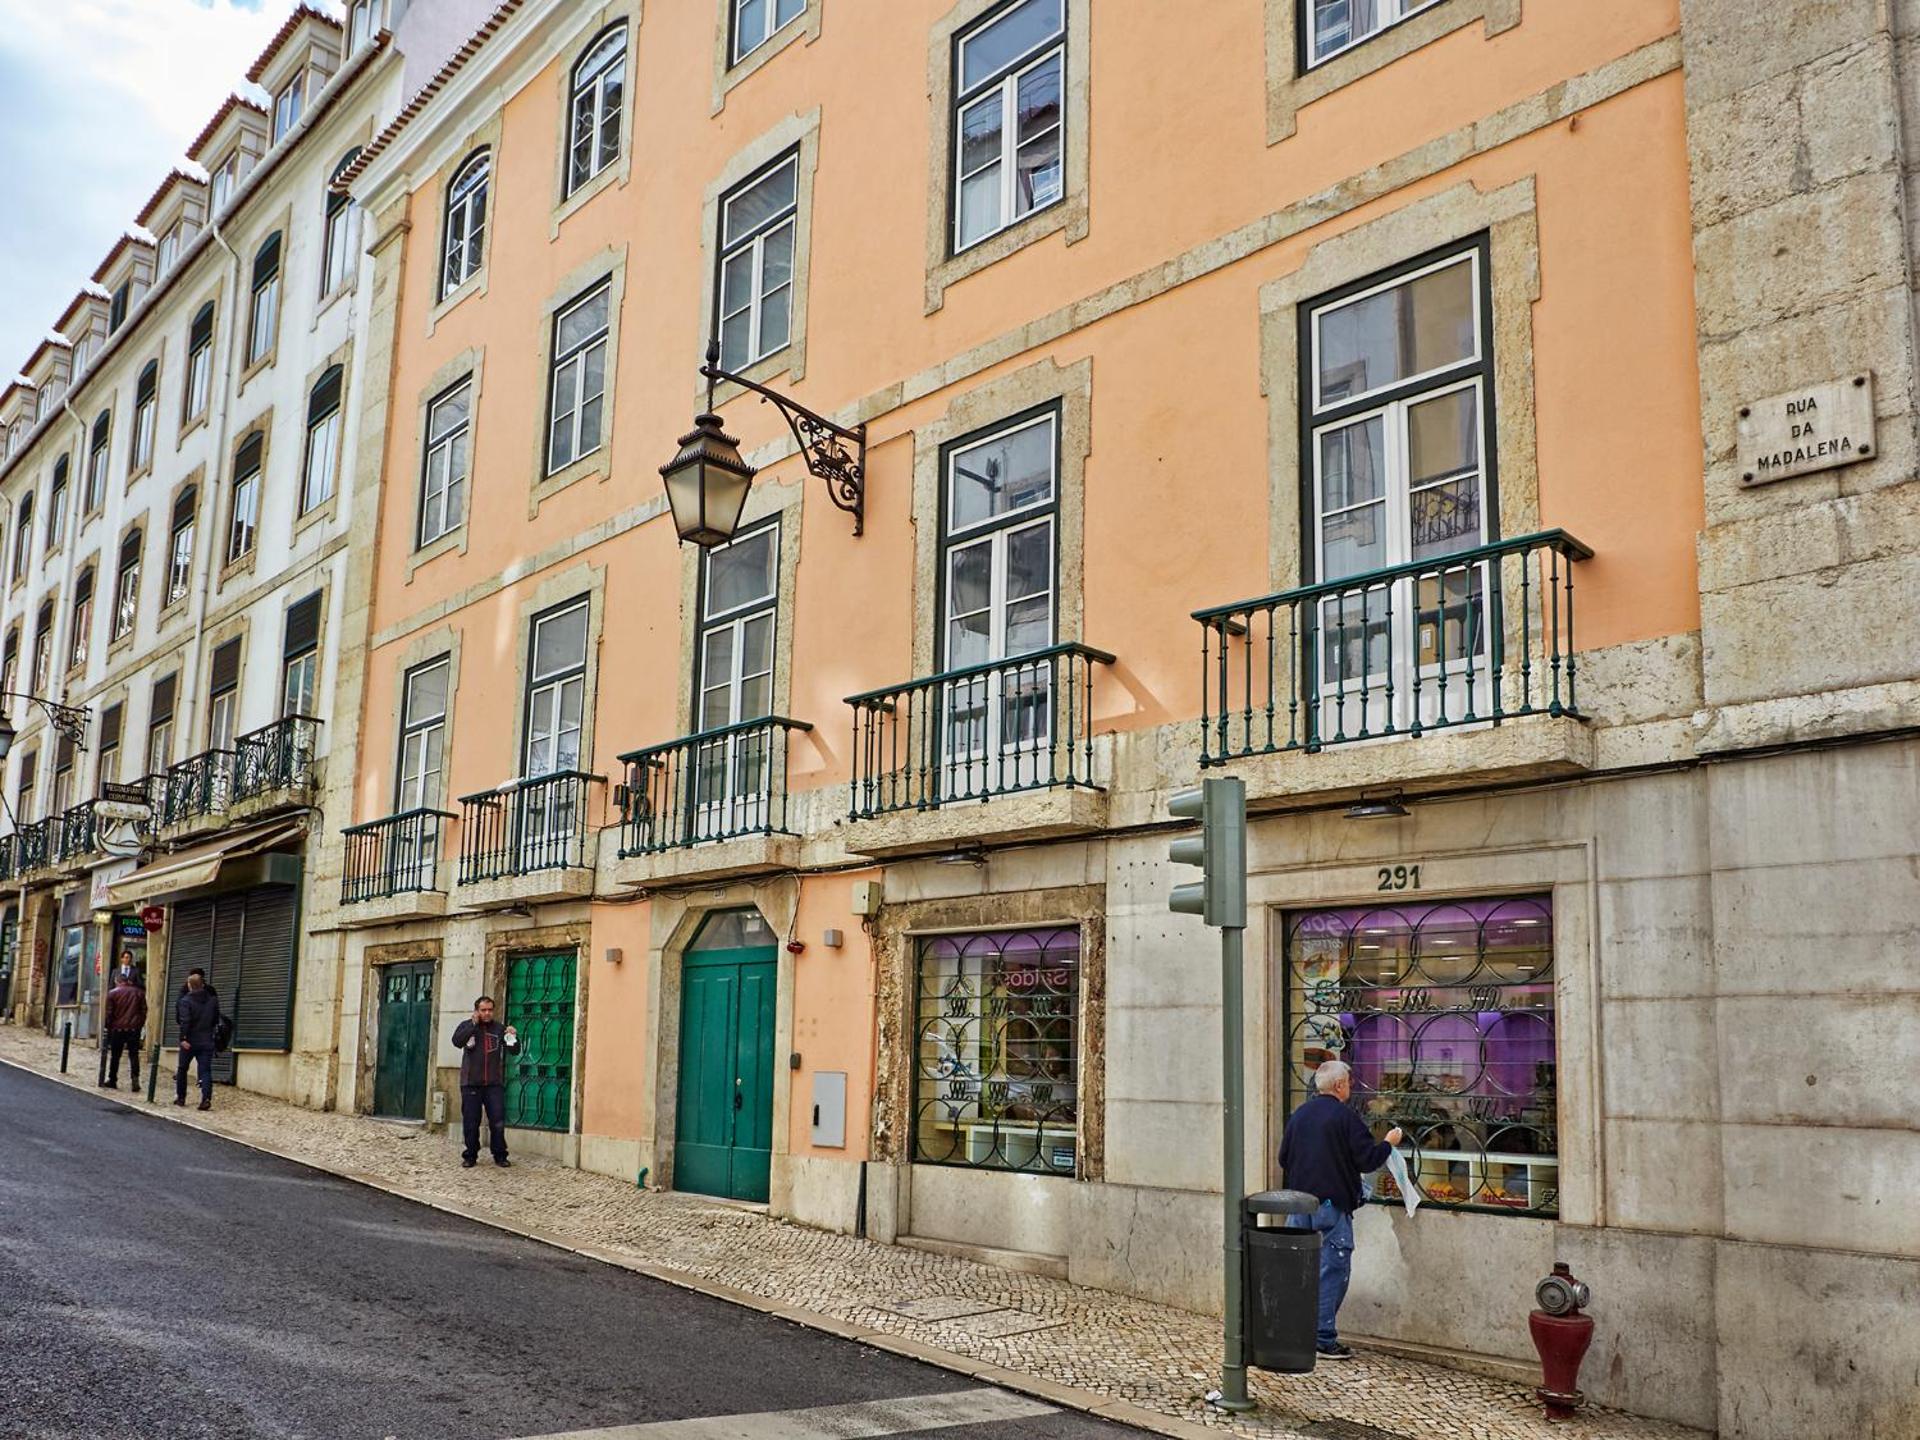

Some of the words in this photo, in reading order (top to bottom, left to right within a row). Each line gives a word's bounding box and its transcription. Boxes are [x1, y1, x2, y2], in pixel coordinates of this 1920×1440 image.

[1786, 397, 1817, 416] RUA
[1791, 422, 1814, 439] DA
[1757, 436, 1852, 471] MADALENA
[1377, 864, 1421, 891] 291
